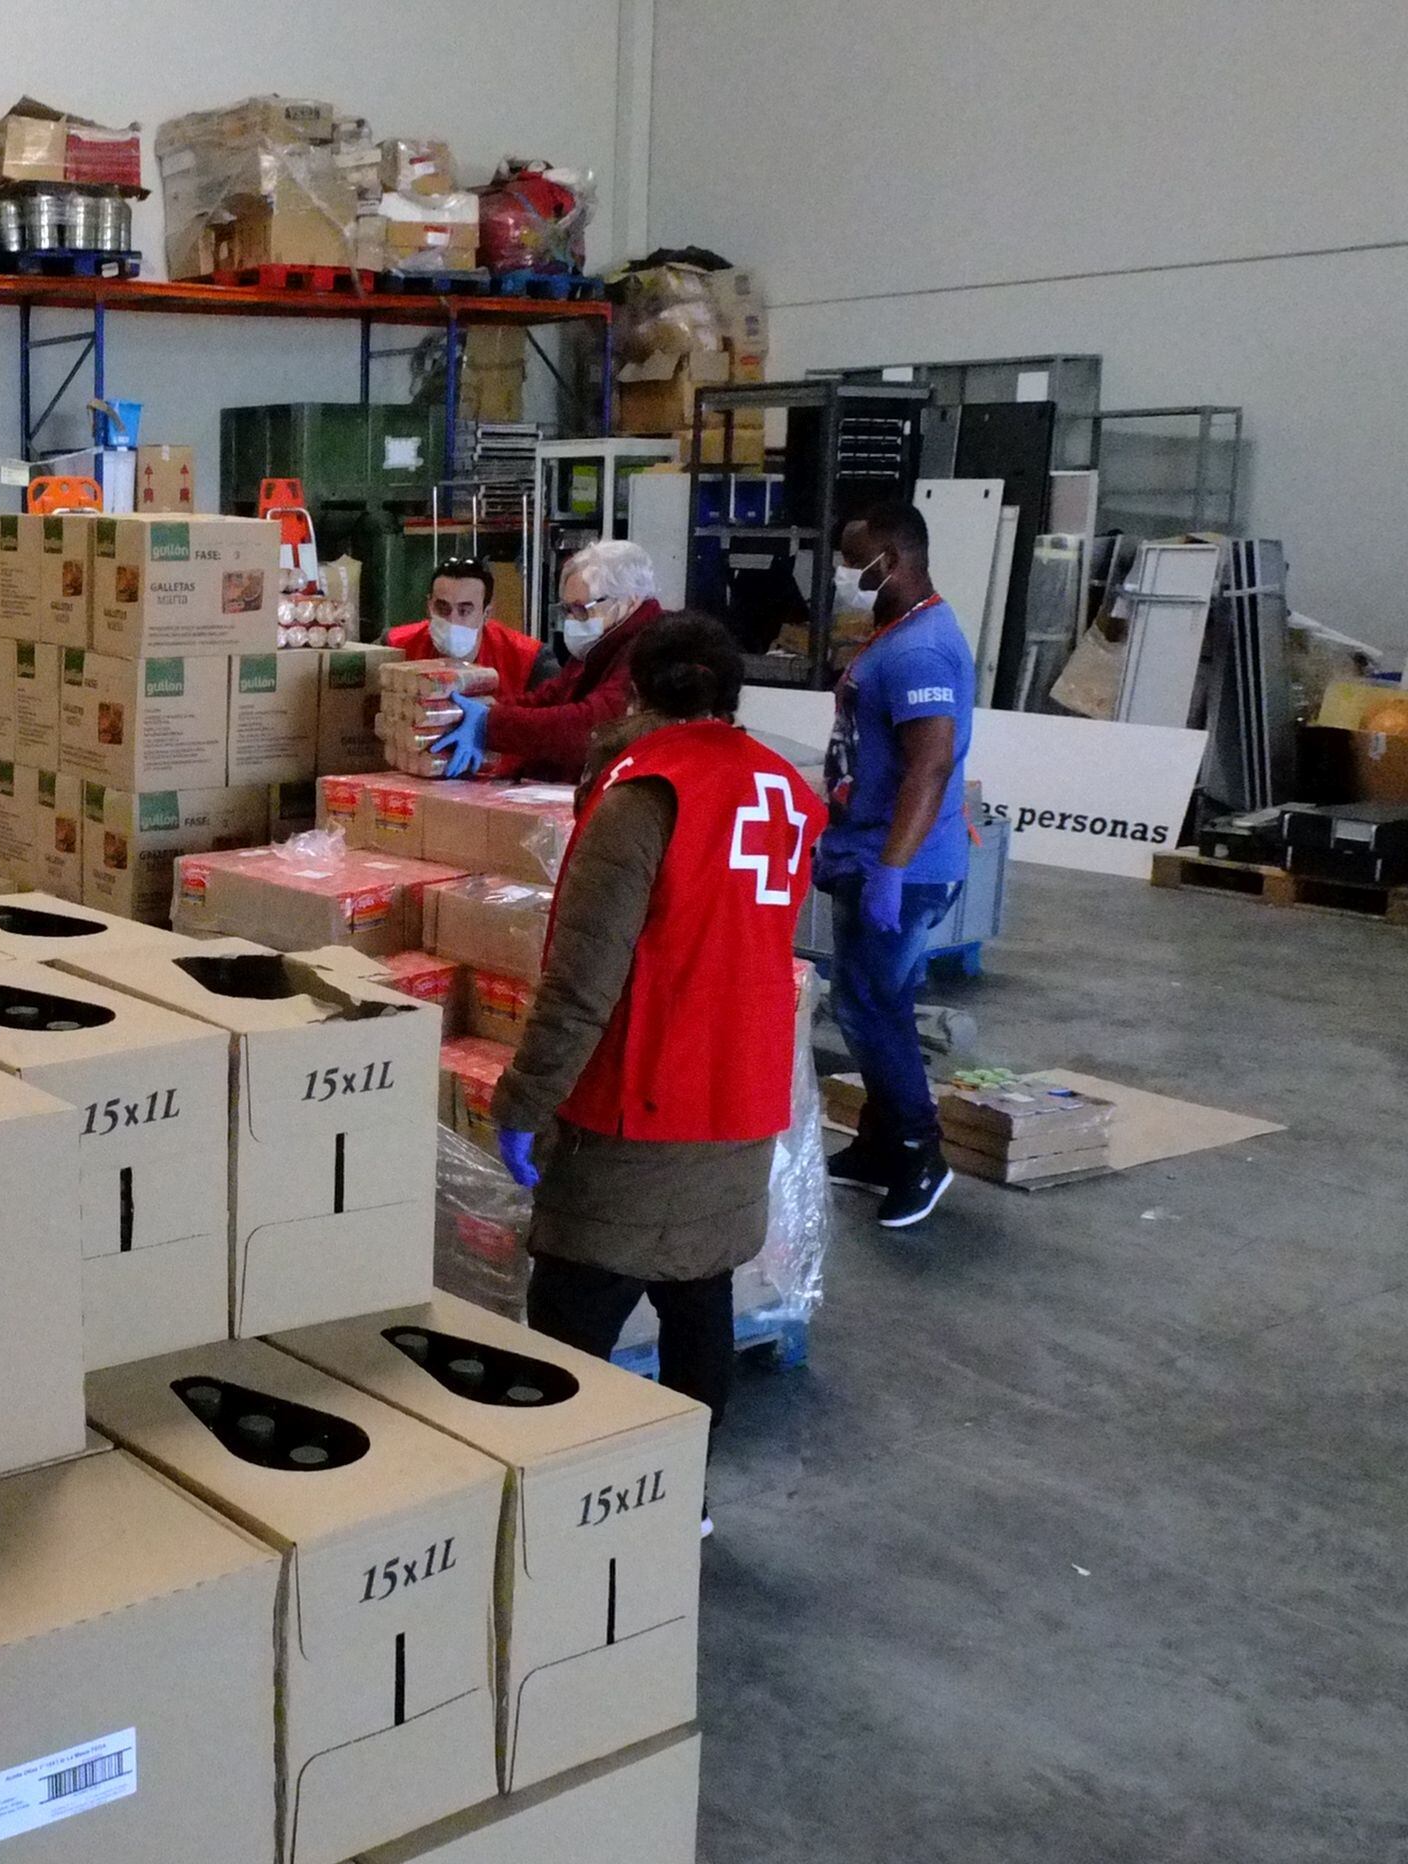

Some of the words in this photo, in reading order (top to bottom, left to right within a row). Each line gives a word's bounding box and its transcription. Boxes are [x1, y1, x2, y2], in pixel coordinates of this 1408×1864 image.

[150, 582, 196, 593] GALLETAS
[907, 687, 955, 705] DIESEL
[1014, 806, 1169, 844] personas
[301, 1060, 394, 1102] 15x1L
[80, 1088, 180, 1136] 15x1L
[577, 1469, 666, 1527] 15x1L
[359, 1536, 456, 1604] 15x1L
